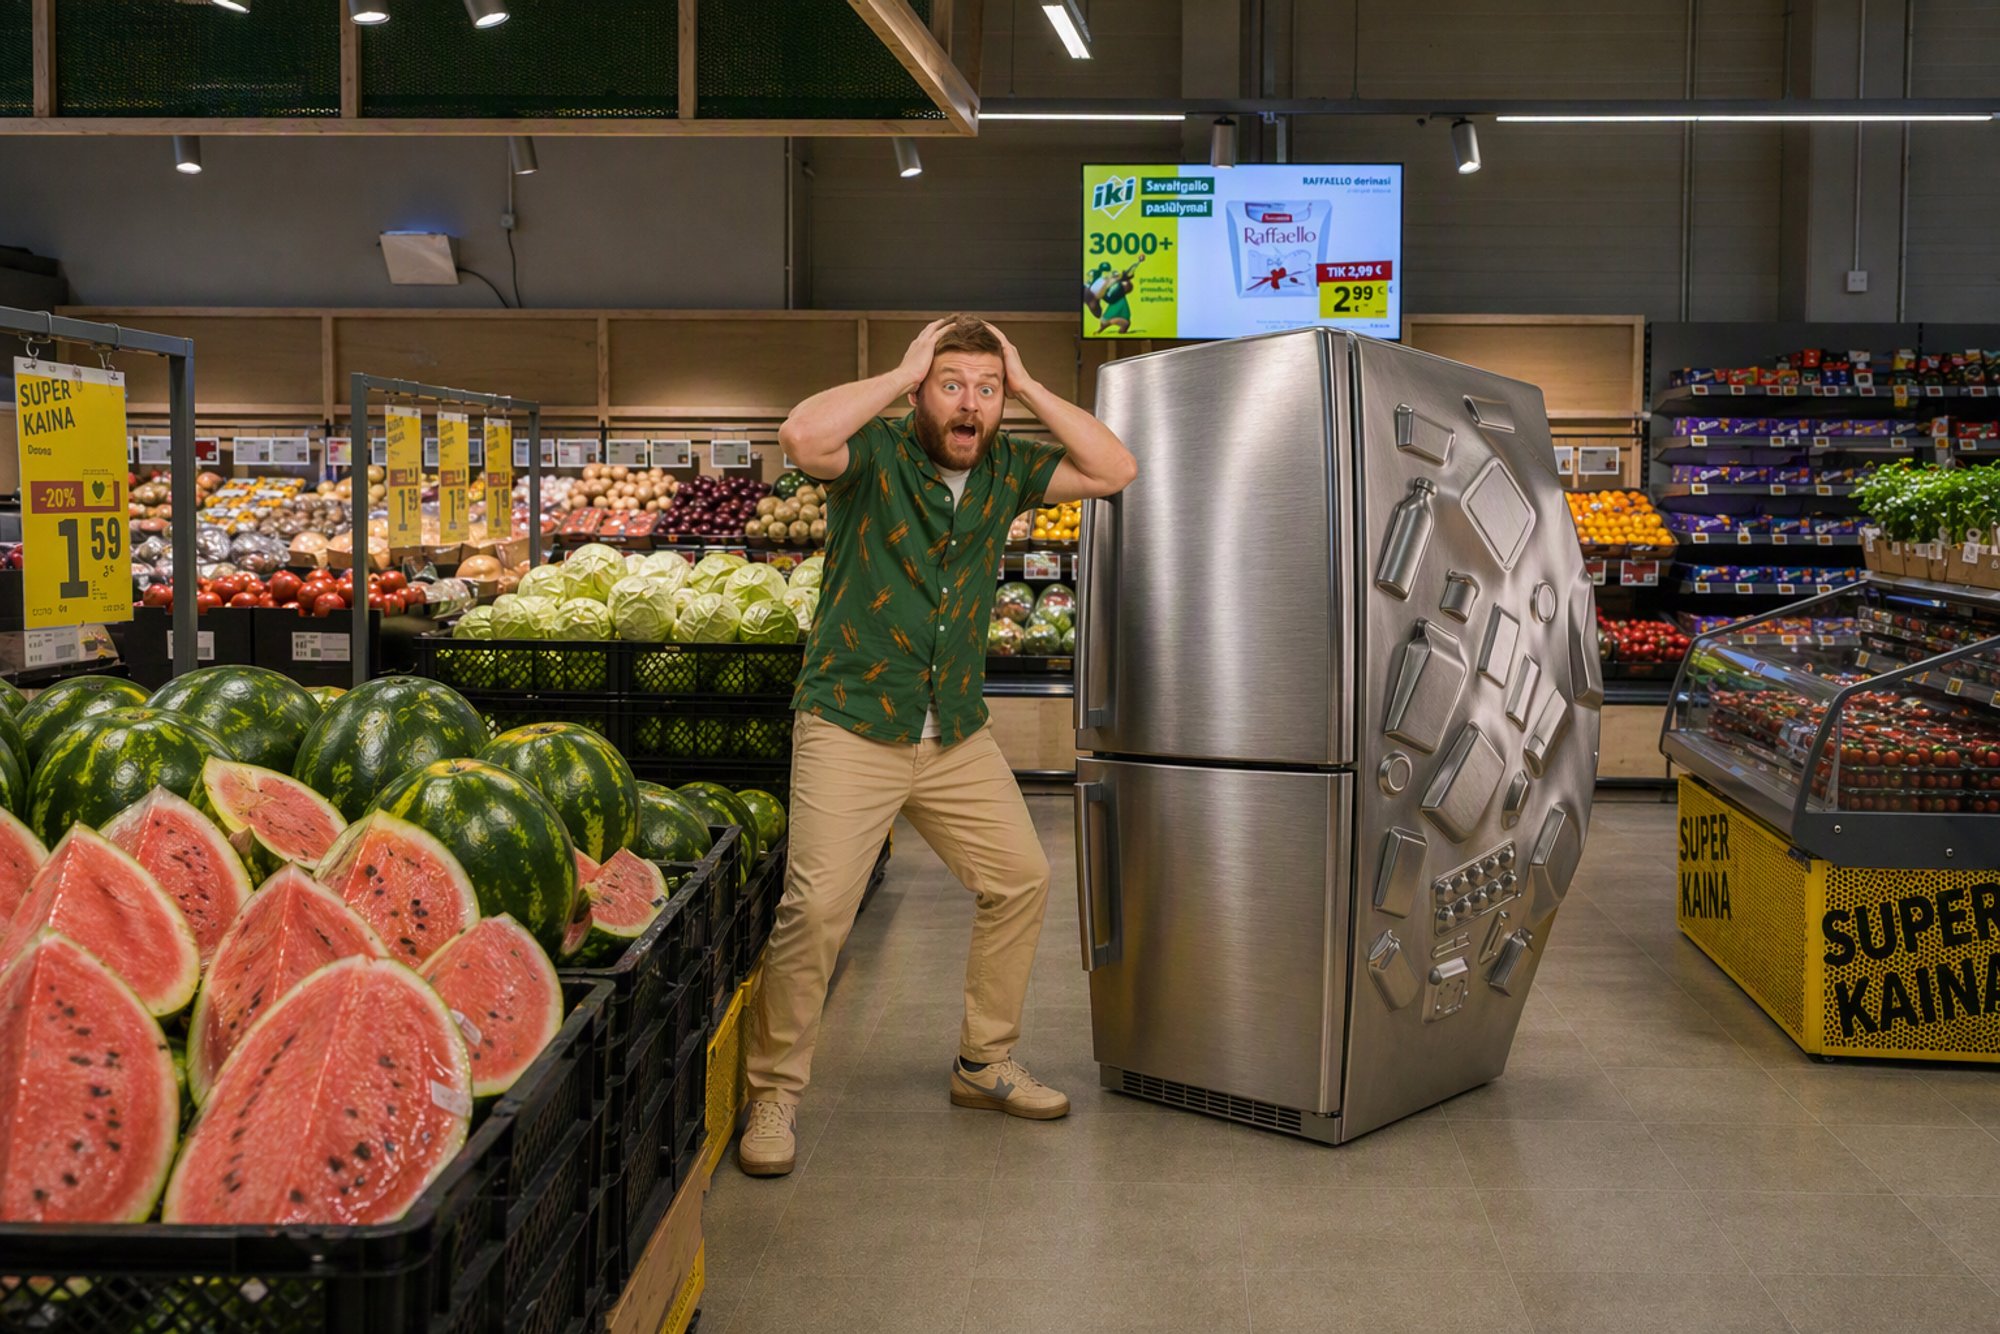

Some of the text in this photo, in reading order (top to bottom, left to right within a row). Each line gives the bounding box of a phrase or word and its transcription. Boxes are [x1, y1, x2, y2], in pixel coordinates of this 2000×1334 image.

[1093, 177, 1135, 209] iki
[1302, 176, 1352, 186] RAFFAELLO
[1089, 232, 1173, 255] 3000+
[1244, 226, 1316, 245] Raffaello
[1326, 266, 1347, 278] TIK
[1347, 265, 1374, 279] 2,99
[1333, 286, 1351, 313] 2
[1352, 285, 1374, 301] 99
[20, 378, 72, 407] SUPER
[23, 406, 76, 436] KAINA
[40, 487, 76, 508] -20%
[58, 516, 121, 599] 1 59
[1680, 813, 1730, 862] SUPER
[1682, 871, 1731, 920] KAINA
[1821, 882, 2000, 967] SUPER
